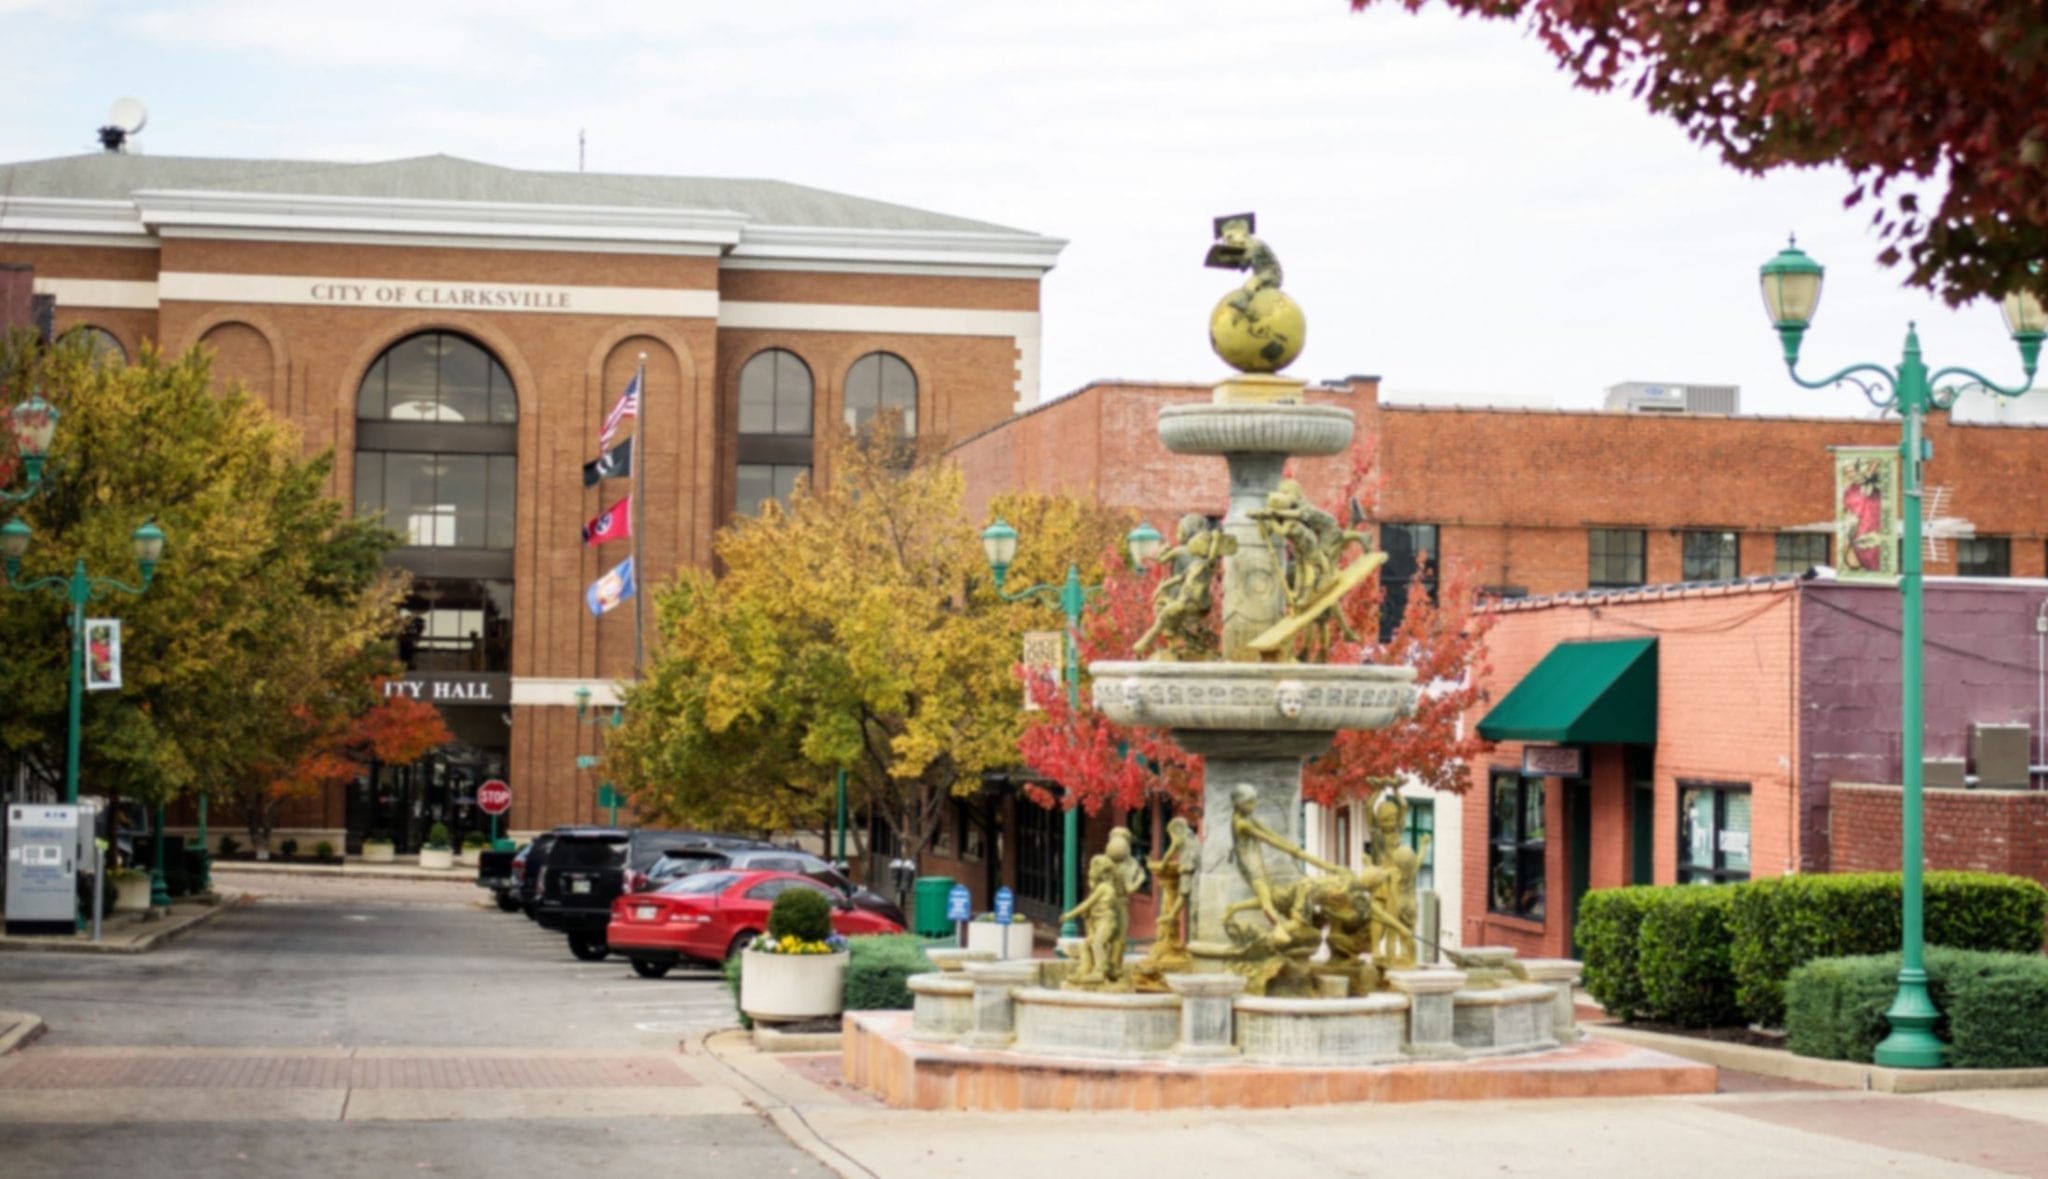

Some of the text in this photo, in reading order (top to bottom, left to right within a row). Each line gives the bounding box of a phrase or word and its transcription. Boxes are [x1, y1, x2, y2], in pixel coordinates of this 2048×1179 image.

[311, 284, 573, 308] CITY OF CLARKSVILLE
[384, 682, 493, 699] ITY HALL
[480, 790, 510, 804] STOP
